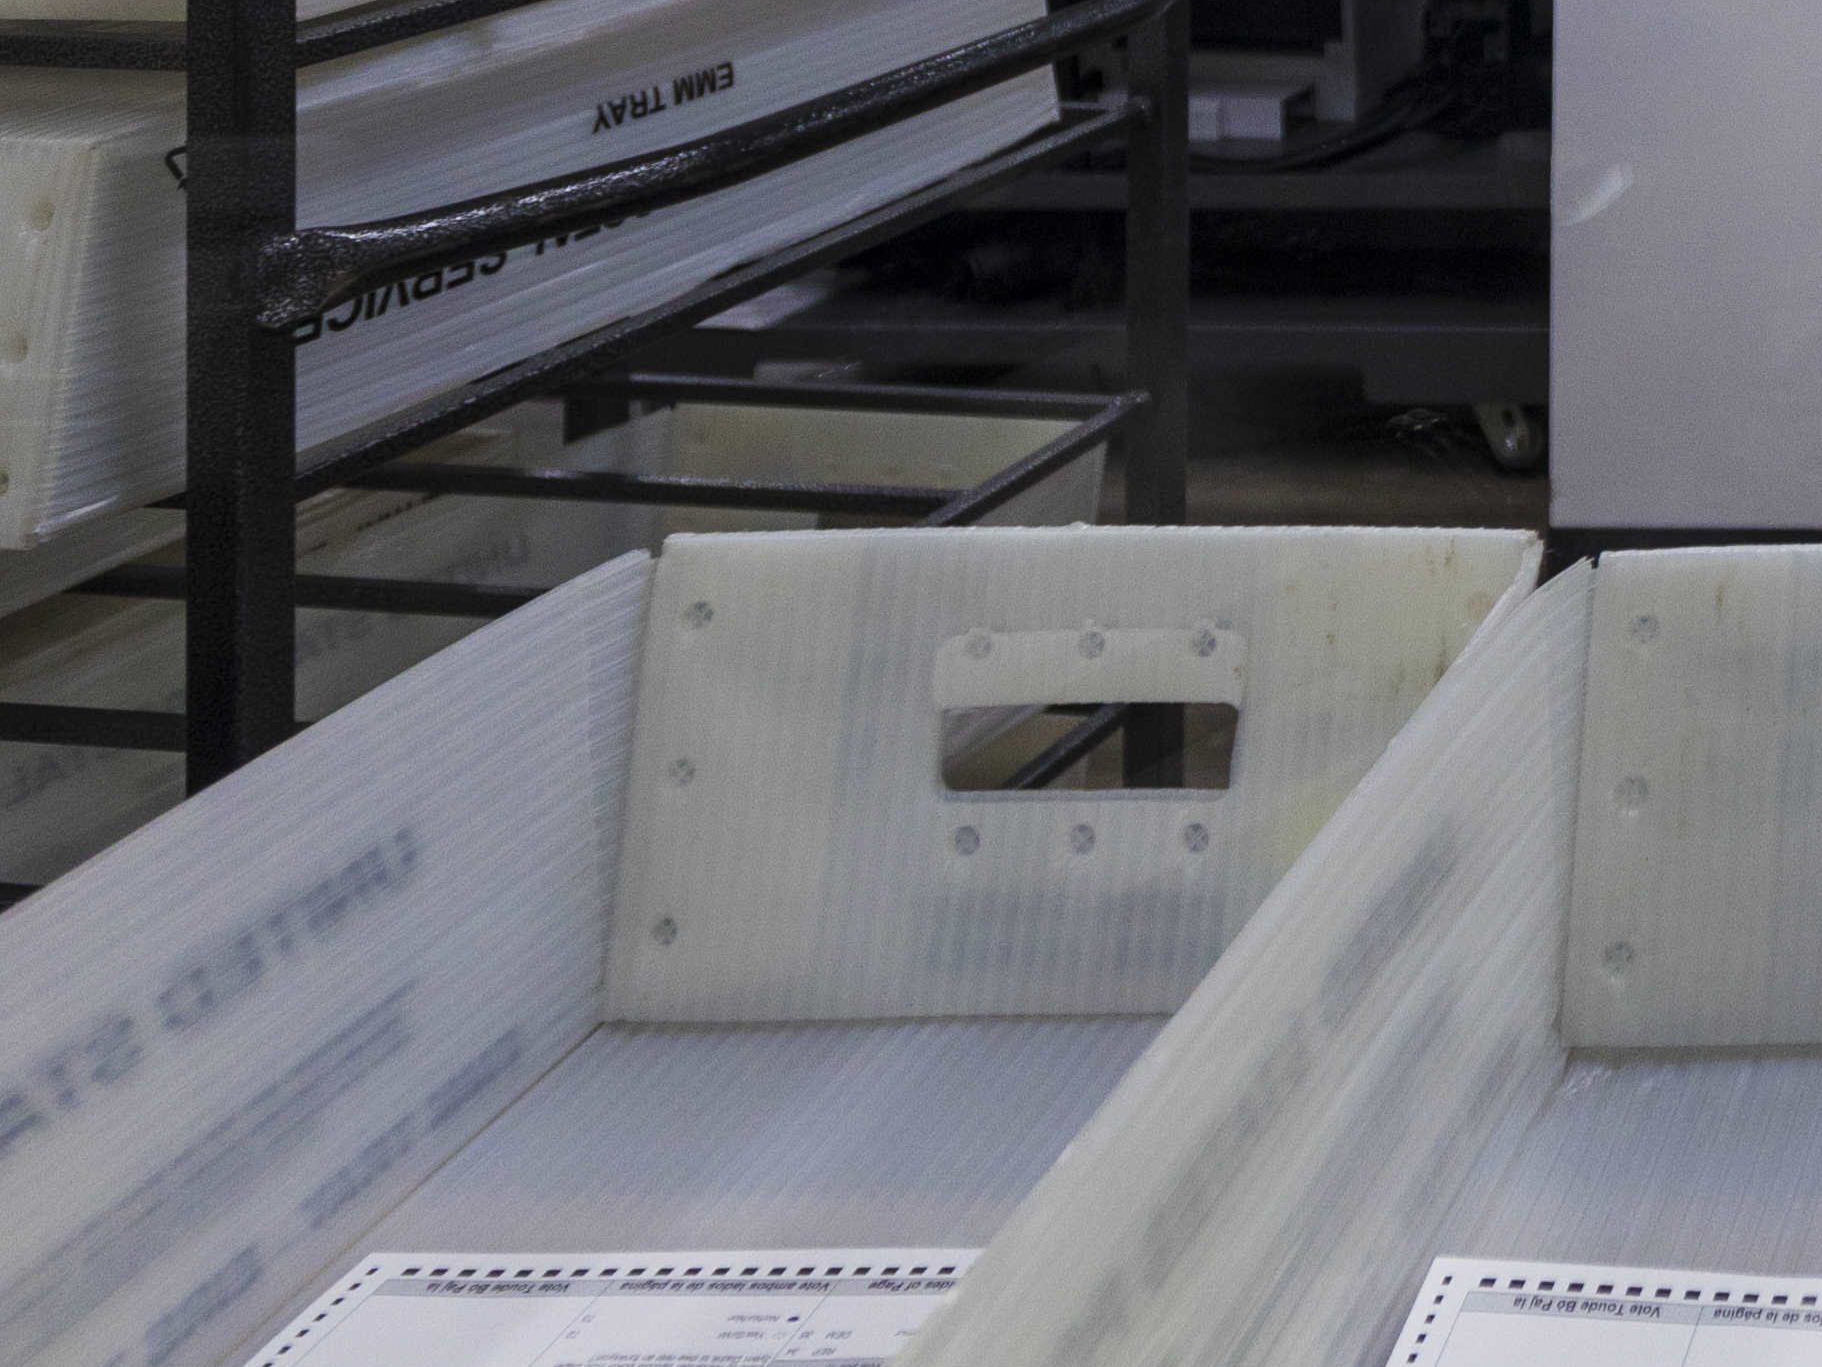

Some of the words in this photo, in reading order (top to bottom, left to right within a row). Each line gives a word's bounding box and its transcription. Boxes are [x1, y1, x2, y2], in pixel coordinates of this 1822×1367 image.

[672, 61, 735, 103] EMM
[590, 86, 666, 134] TRAY
[1513, 1297, 1527, 1311] la
[1529, 1295, 1554, 1312] Paj
[1580, 1300, 1625, 1318] Toude
[1628, 1303, 1661, 1320] Vote
[1765, 1310, 1779, 1323] la
[1781, 1311, 1800, 1326] de
